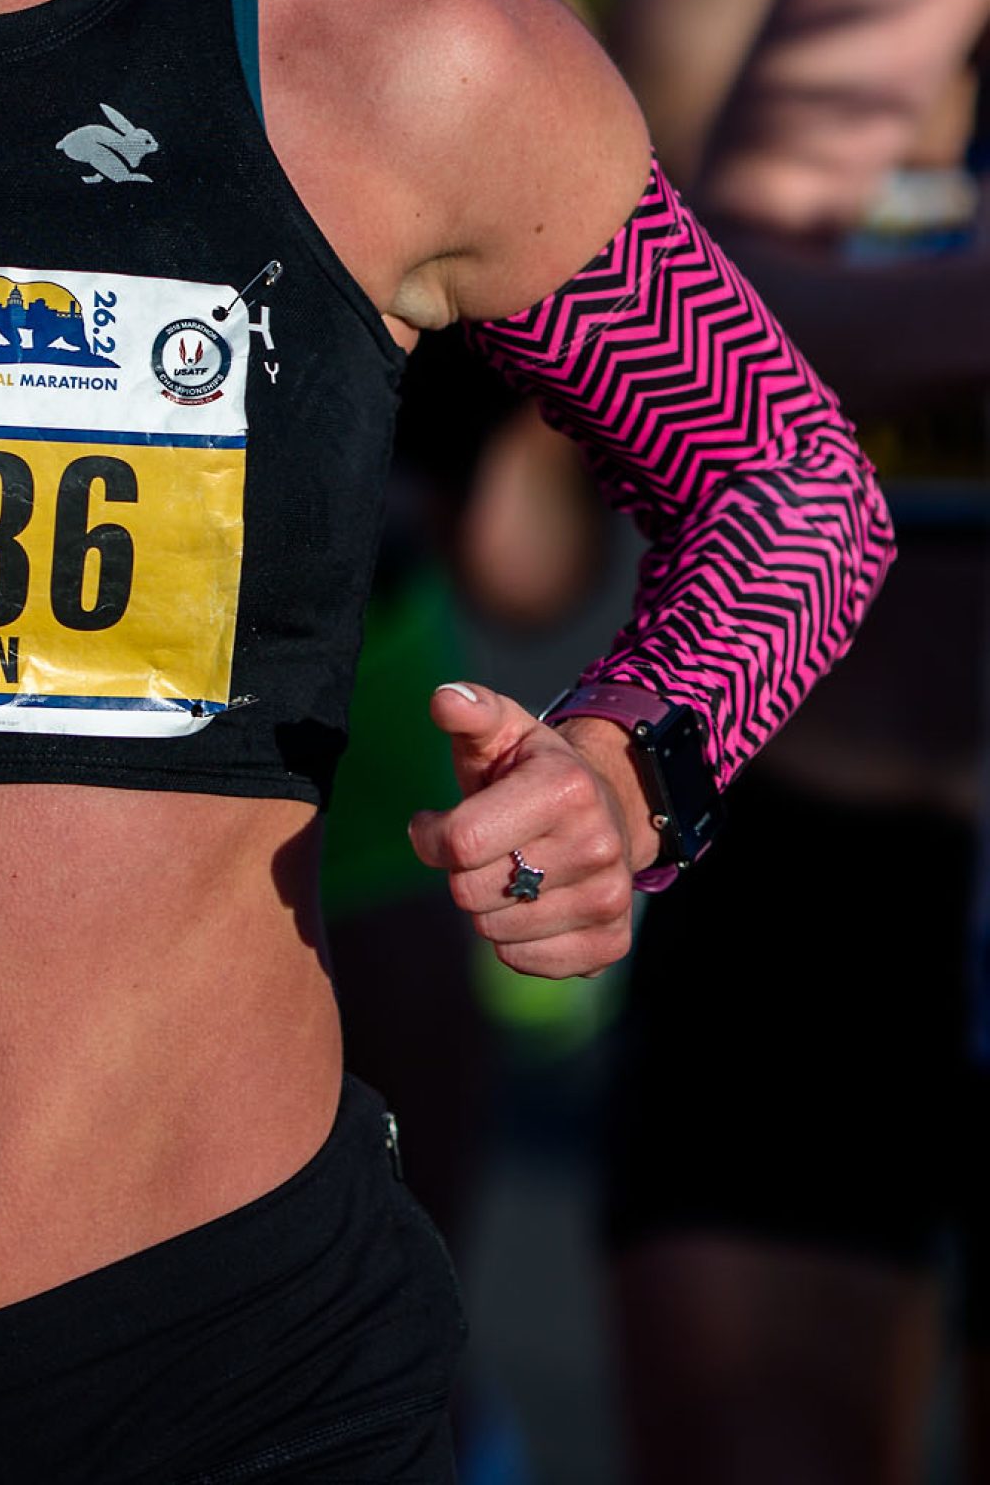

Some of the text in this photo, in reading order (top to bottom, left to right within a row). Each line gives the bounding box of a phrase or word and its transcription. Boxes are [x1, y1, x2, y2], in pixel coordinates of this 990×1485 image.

[93, 290, 117, 355] 26.2
[181, 321, 219, 341] MARATHON
[174, 367, 210, 376] USATF
[20, 374, 118, 391] MARATHON
[159, 373, 224, 396] CHAMPIONSHIPS
